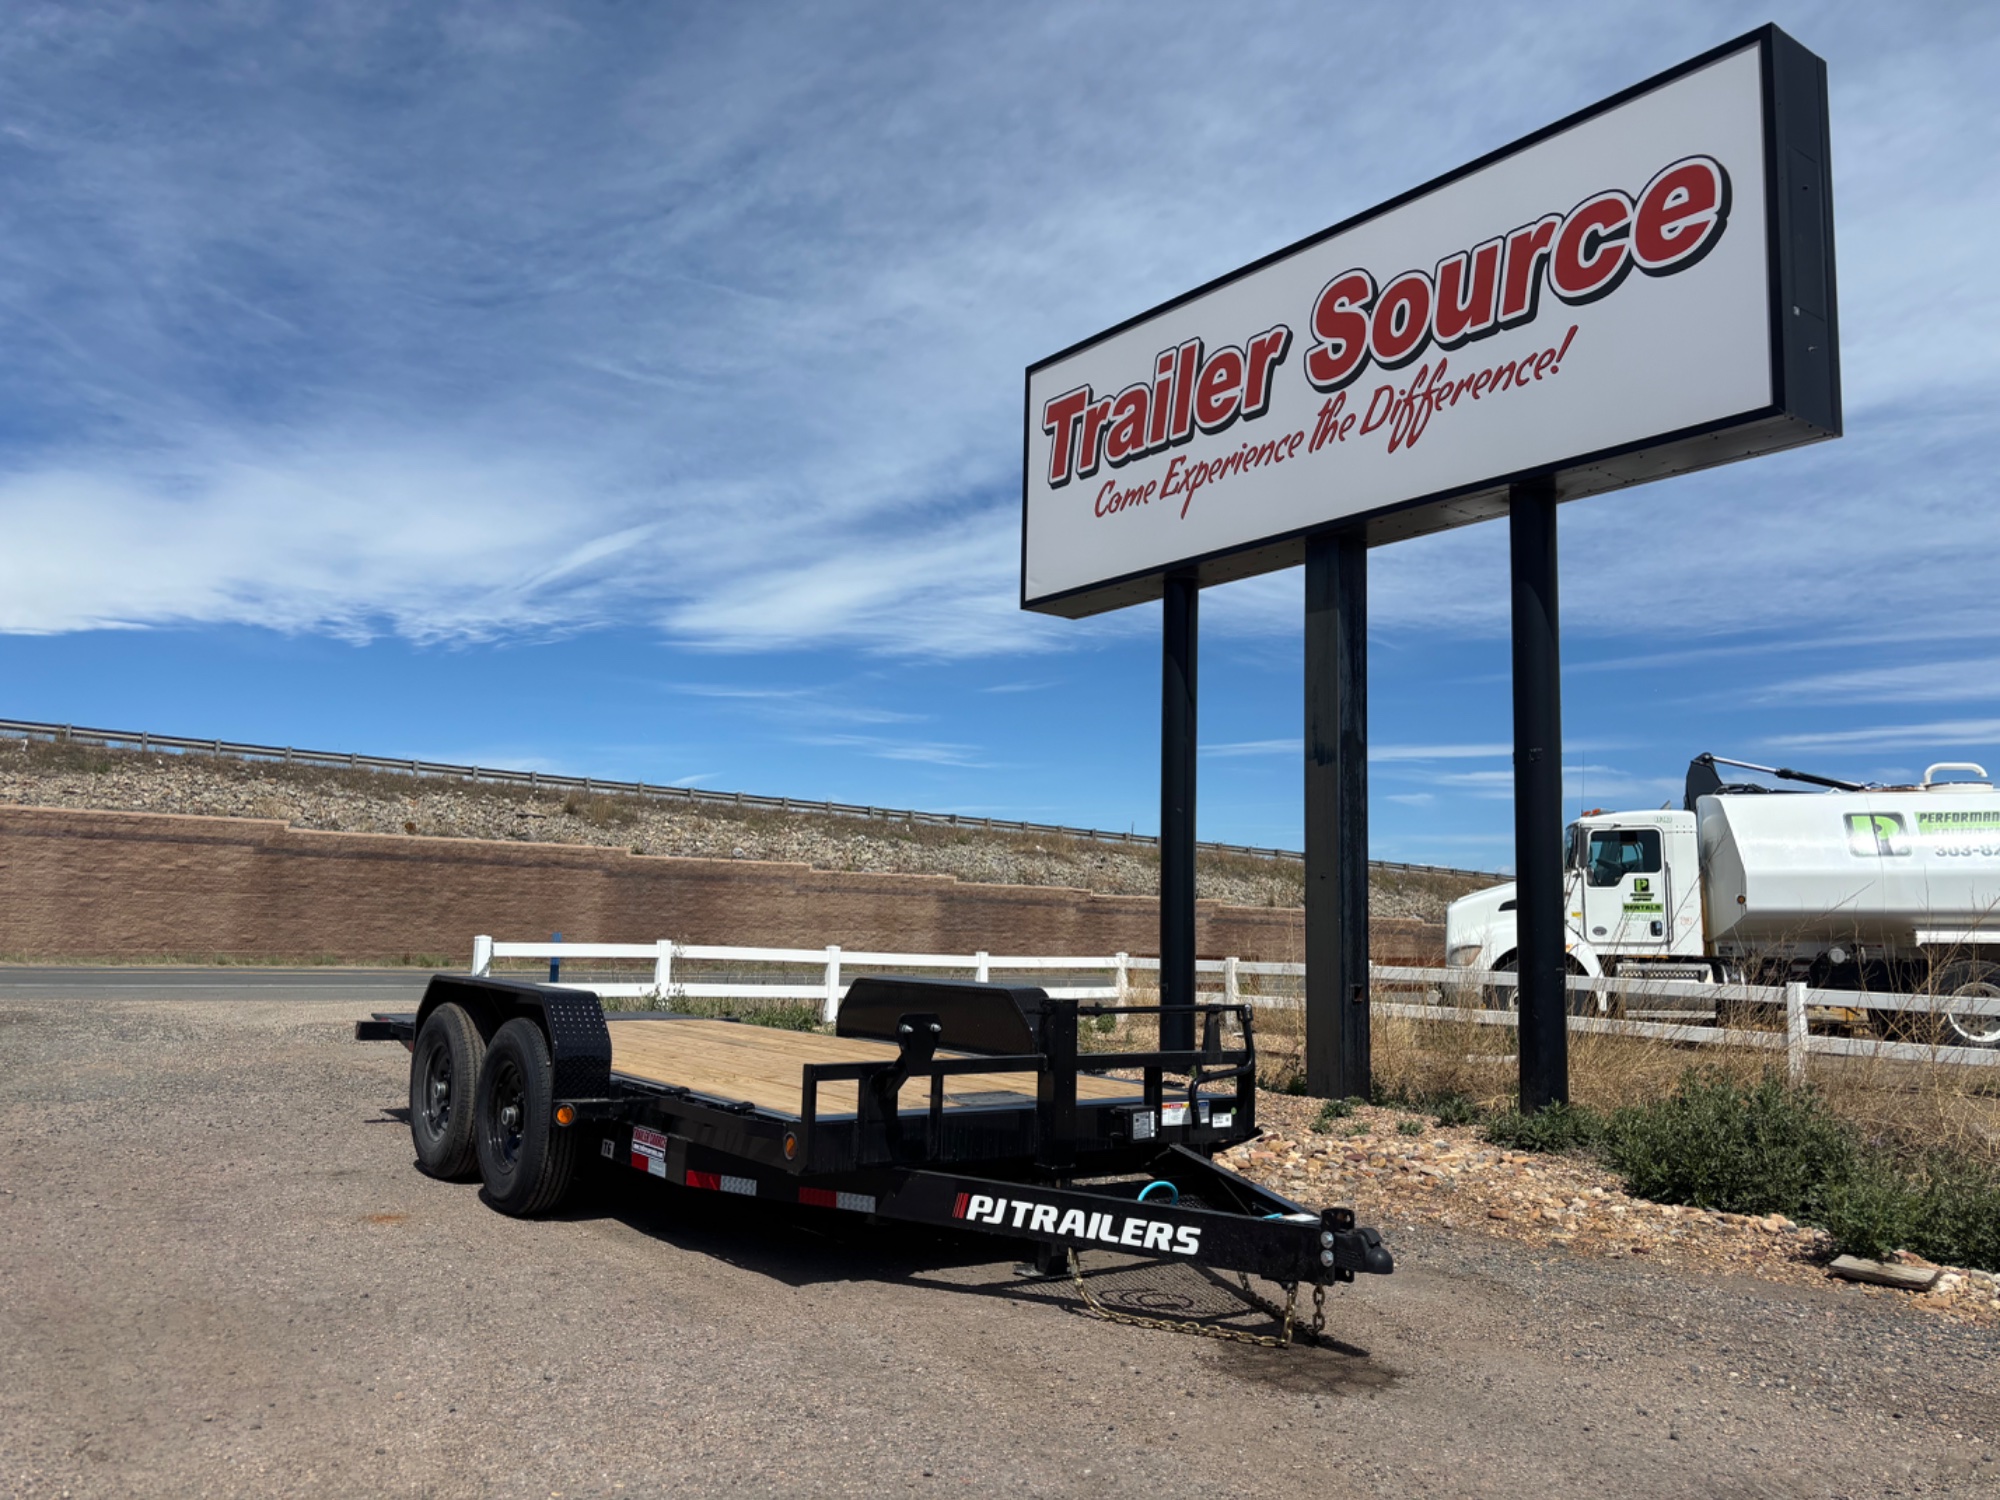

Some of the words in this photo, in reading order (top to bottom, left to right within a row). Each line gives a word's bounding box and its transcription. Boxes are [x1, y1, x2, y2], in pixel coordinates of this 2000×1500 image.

[1042, 324, 1292, 488] Trailer
[1304, 155, 1732, 393] Source
[1094, 479, 1157, 518] Come
[1159, 430, 1305, 519] Experience
[1308, 390, 1357, 454] the
[1359, 324, 1579, 454] Difference!
[967, 1195, 1007, 1225] PJ
[1011, 1200, 1202, 1256] TRAILERS
